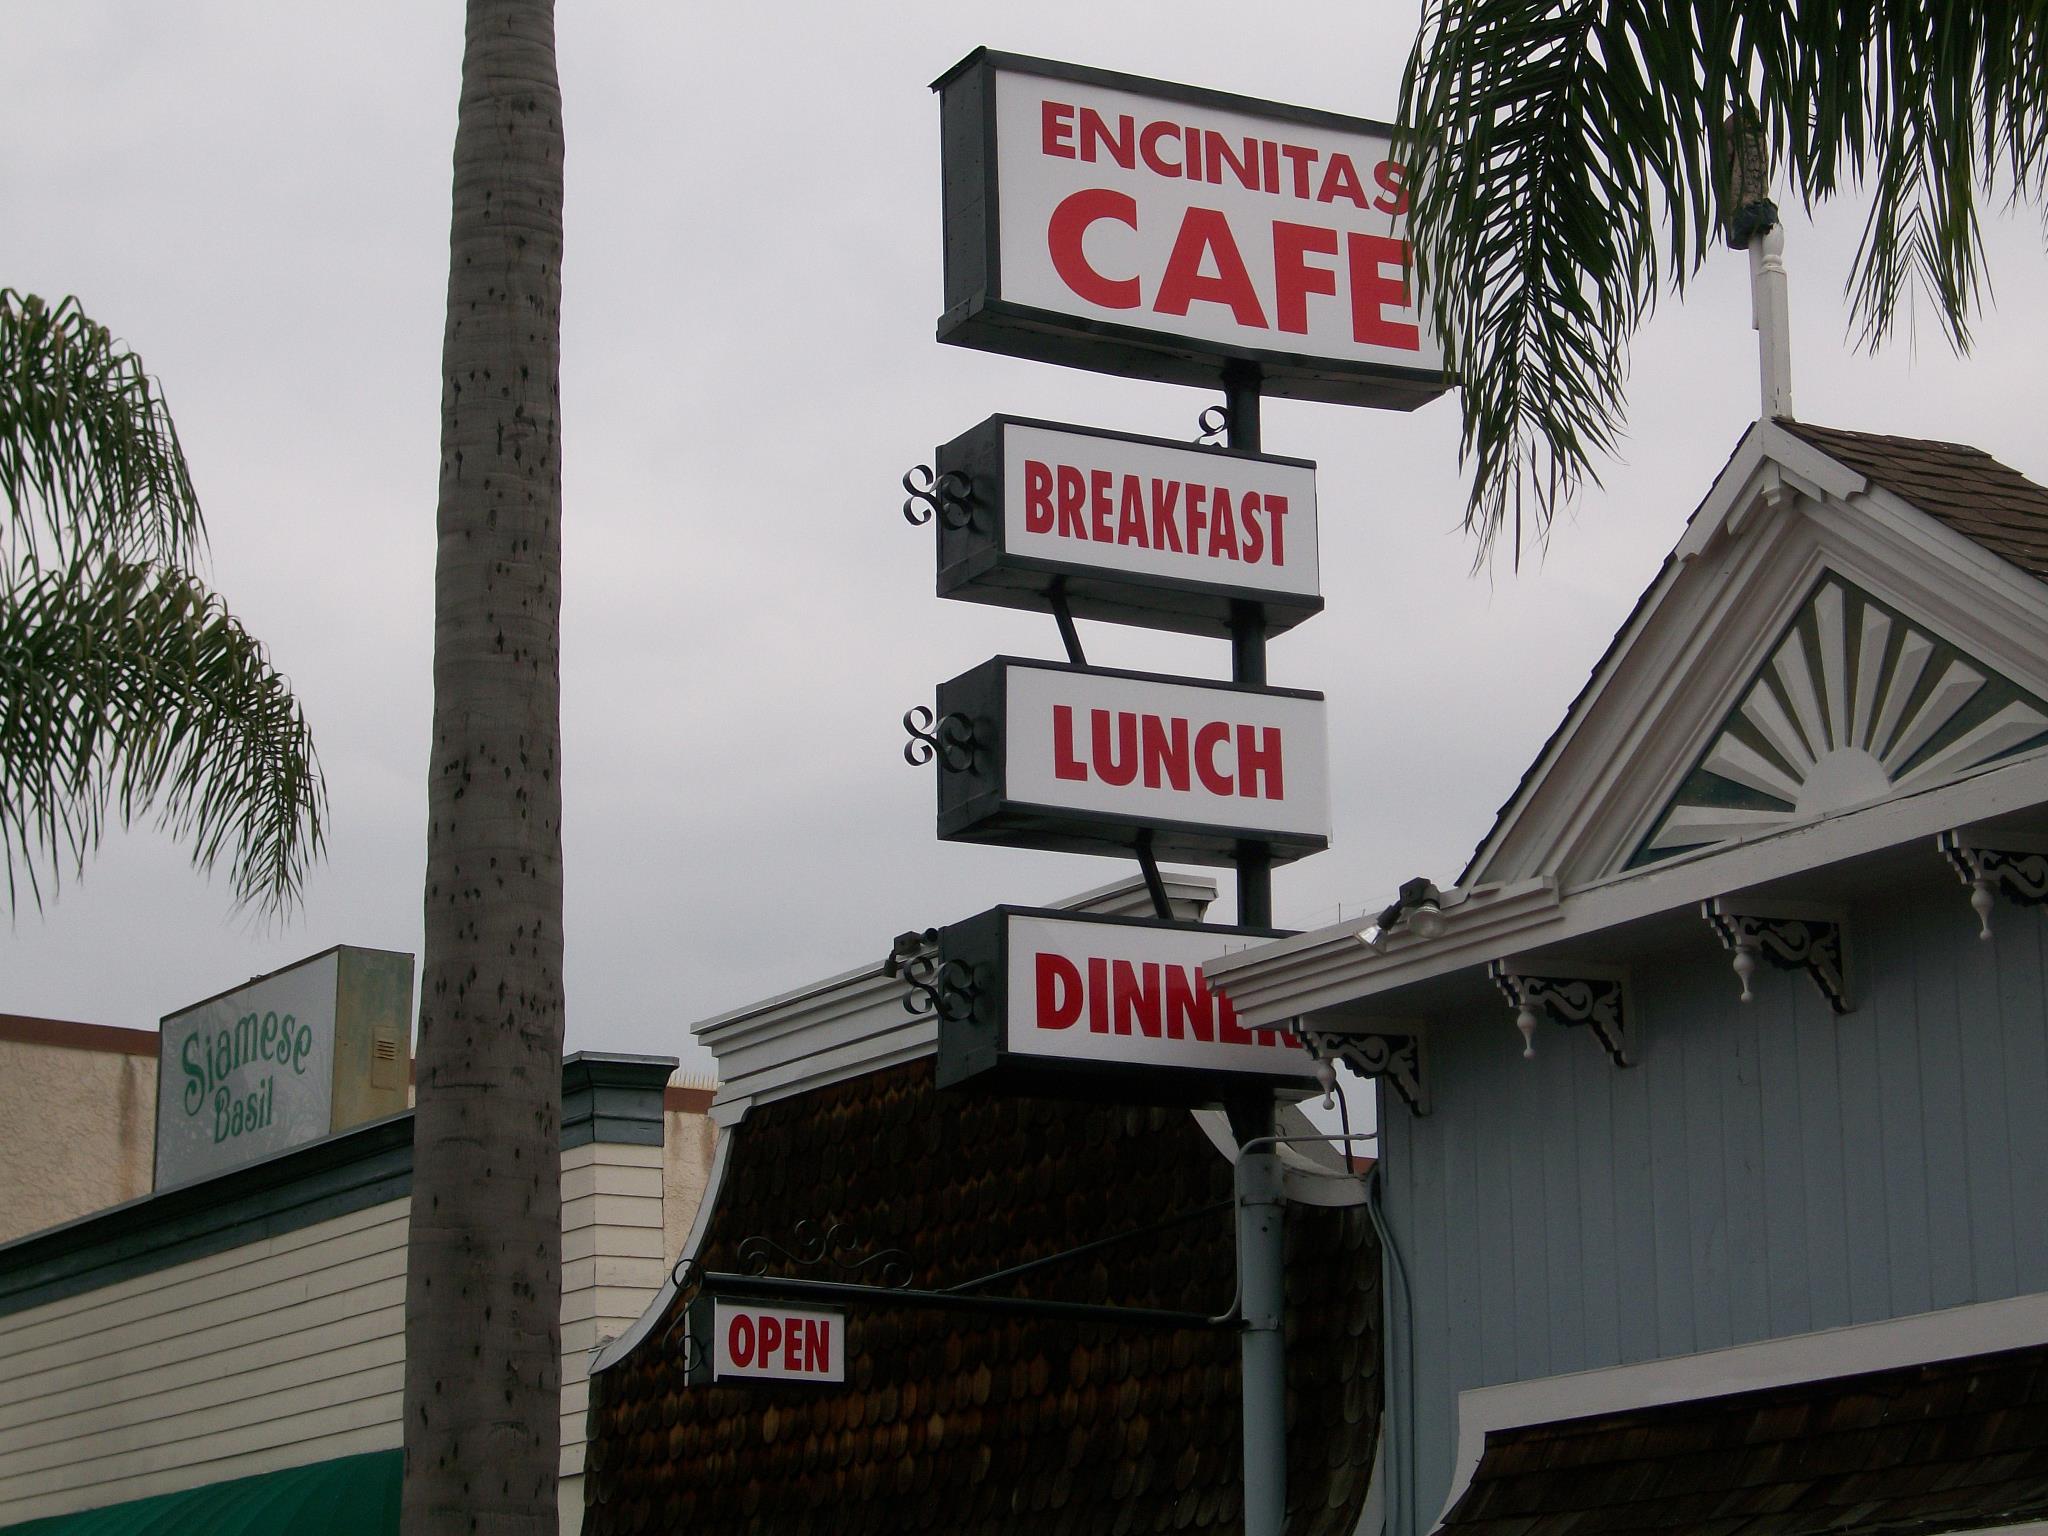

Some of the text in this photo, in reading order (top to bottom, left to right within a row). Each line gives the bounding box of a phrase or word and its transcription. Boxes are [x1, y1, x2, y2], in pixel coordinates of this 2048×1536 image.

[1041, 100, 1411, 216] ENCINITAS
[1048, 188, 1420, 352] CAFE
[1025, 460, 1289, 567] BREAKFAST
[1053, 705, 1284, 801] LUNCH
[1035, 952, 1304, 1049] DINNE
[181, 1011, 312, 1117] Siamese
[213, 1075, 274, 1144] Basil
[728, 1314, 830, 1373] OPEN
